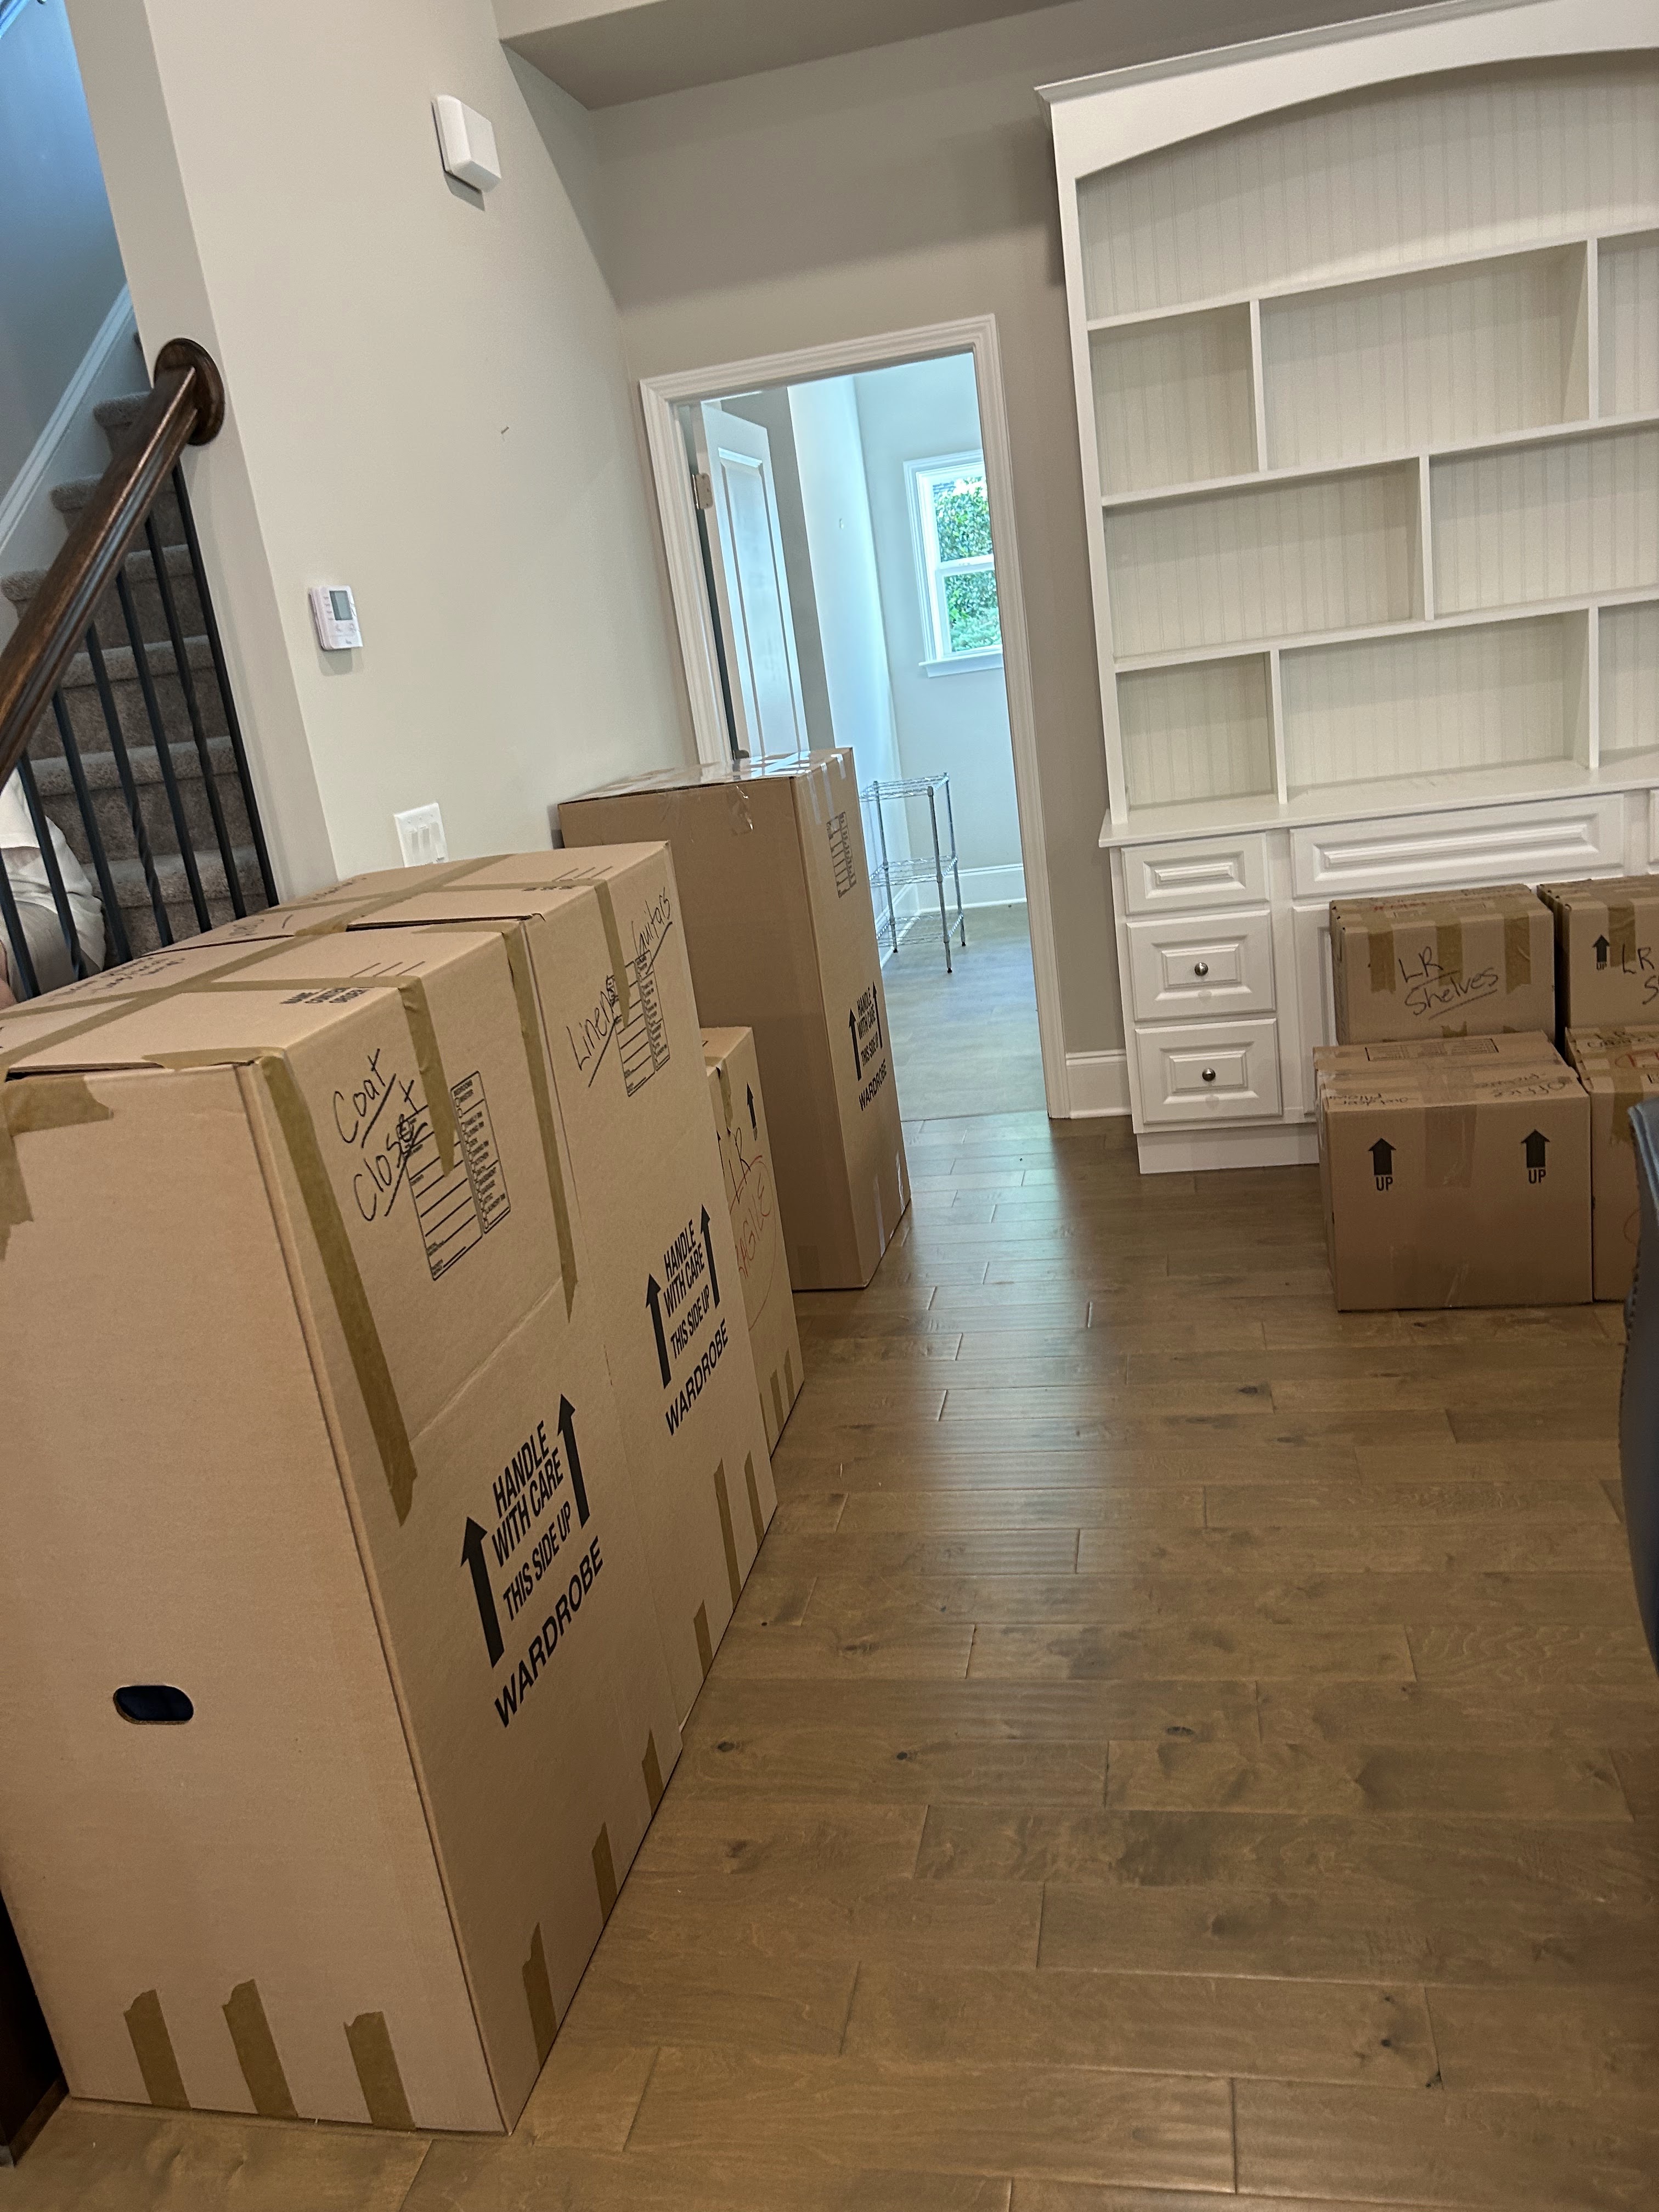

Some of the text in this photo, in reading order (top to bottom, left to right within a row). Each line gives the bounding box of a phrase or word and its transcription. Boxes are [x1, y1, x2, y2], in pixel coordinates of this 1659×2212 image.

[1398, 946, 1444, 983] LR
[1596, 962, 1608, 971] UP
[1622, 943, 1655, 974] LR
[856, 986, 871, 1018] HANDLE
[1404, 967, 1499, 1015] Shelves
[856, 1017, 869, 1040] WITH
[333, 1048, 386, 1143] Coat
[859, 1058, 887, 1111] WARDROBE
[729, 1127, 752, 1205] LR
[1376, 1176, 1393, 1191] UP
[1528, 1169, 1547, 1184] UP
[663, 1218, 697, 1282] HANDLE
[663, 1242, 705, 1318] WITH CARE
[670, 1284, 710, 1359] THIS SIDE UP
[665, 1317, 729, 1436] WARDROBE
[493, 1420, 550, 1519] HANDLE
[492, 1447, 565, 1568] WITH CARE
[503, 1500, 572, 1621] THIS SIDE UP
[494, 1536, 603, 1728] WARDROBE
